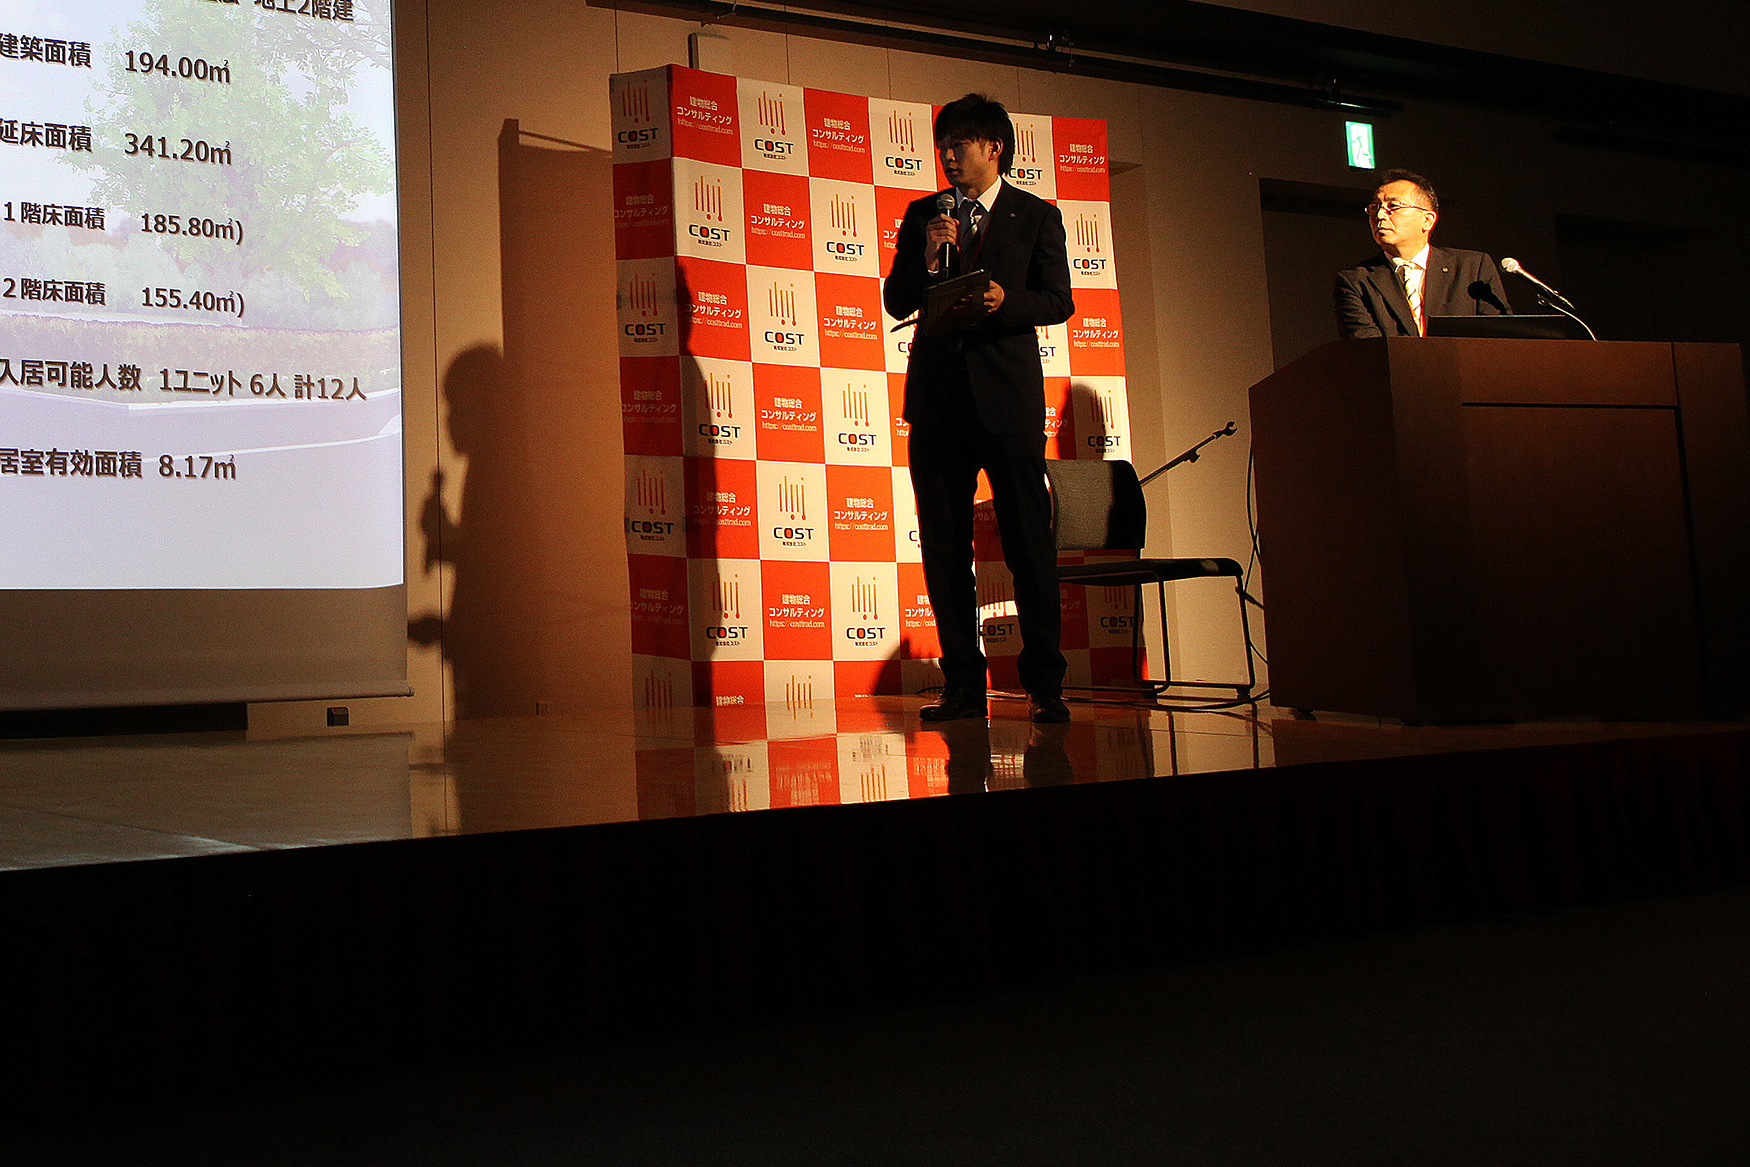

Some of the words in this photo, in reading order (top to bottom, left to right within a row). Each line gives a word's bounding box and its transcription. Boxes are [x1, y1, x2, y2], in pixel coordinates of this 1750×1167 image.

[677, 106, 732, 125] コンサルティング
[618, 127, 658, 143] COST
[812, 129, 864, 144] コンサルティング
[754, 139, 794, 154] COST
[886, 156, 922, 170] COST
[1060, 154, 1105, 165] コンサルティング
[1009, 168, 1043, 180] COST
[763, 204, 791, 216] 建物総合
[751, 215, 805, 230] コンサルティング
[689, 224, 730, 241] COST
[827, 242, 865, 256] COST
[1073, 259, 1107, 270] COST
[625, 323, 666, 335] COST
[824, 318, 876, 330] コンサルティング
[765, 331, 805, 345] COST
[1073, 330, 1119, 339] コンサルティング
[159, 368, 242, 397] 1ユニット
[250, 373, 286, 397] 6人
[294, 374, 367, 401] 計12人
[761, 410, 817, 421] コンサルティング
[699, 424, 740, 438] COST
[838, 433, 877, 445] COST
[1088, 435, 1121, 446] COST
[834, 511, 888, 521] コンサルティング
[631, 521, 674, 534] COST
[773, 527, 814, 540] COST
[769, 607, 824, 617] コンサルティング
[706, 627, 748, 639] COST
[846, 628, 885, 639] COST
